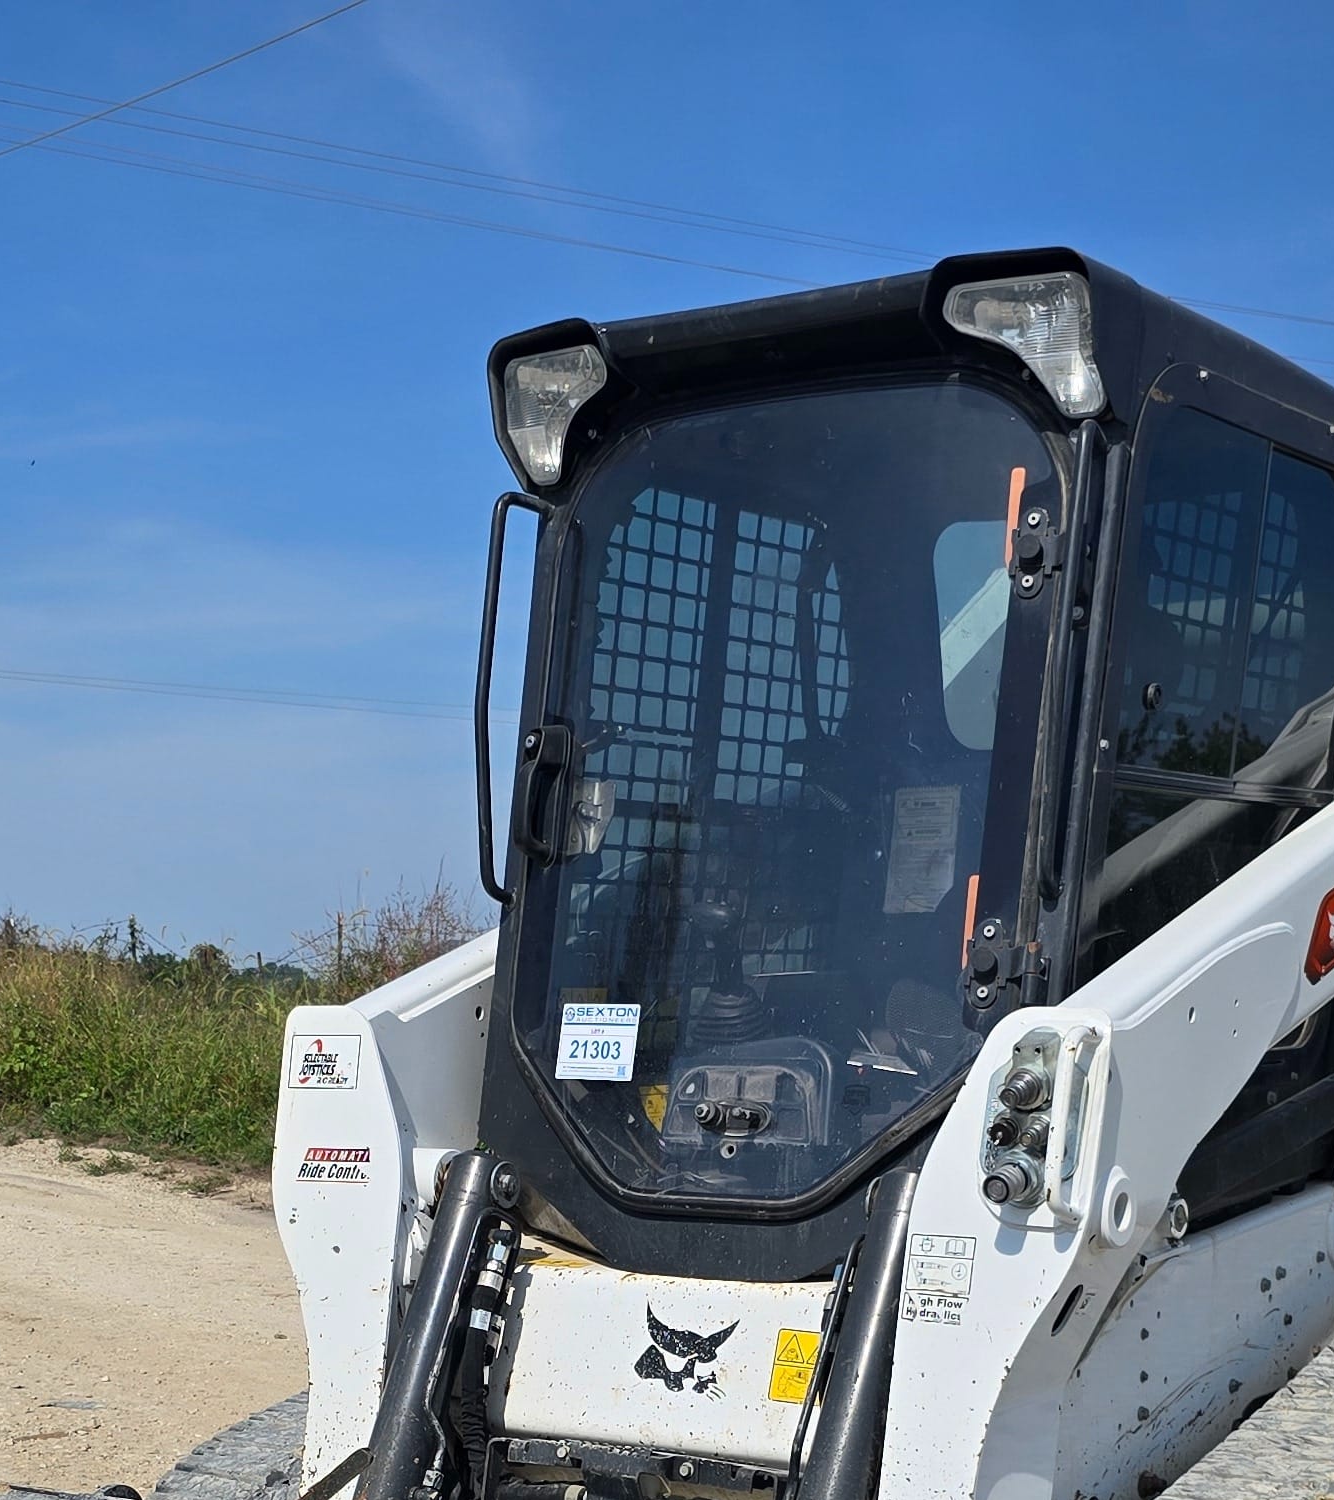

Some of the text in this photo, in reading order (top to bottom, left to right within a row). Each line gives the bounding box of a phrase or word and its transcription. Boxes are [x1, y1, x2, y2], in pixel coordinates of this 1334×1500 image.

[576, 1007, 638, 1017] SEXTON
[569, 1039, 621, 1060] 21303
[302, 1053, 339, 1063] SELECTABLE
[298, 1063, 337, 1076] JOYSTICKS
[307, 1149, 369, 1162] AUTOMATI
[298, 1162, 326, 1179] Ride
[908, 1296, 963, 1309] Hgh Flow
[905, 1306, 961, 1321] Hydralics
